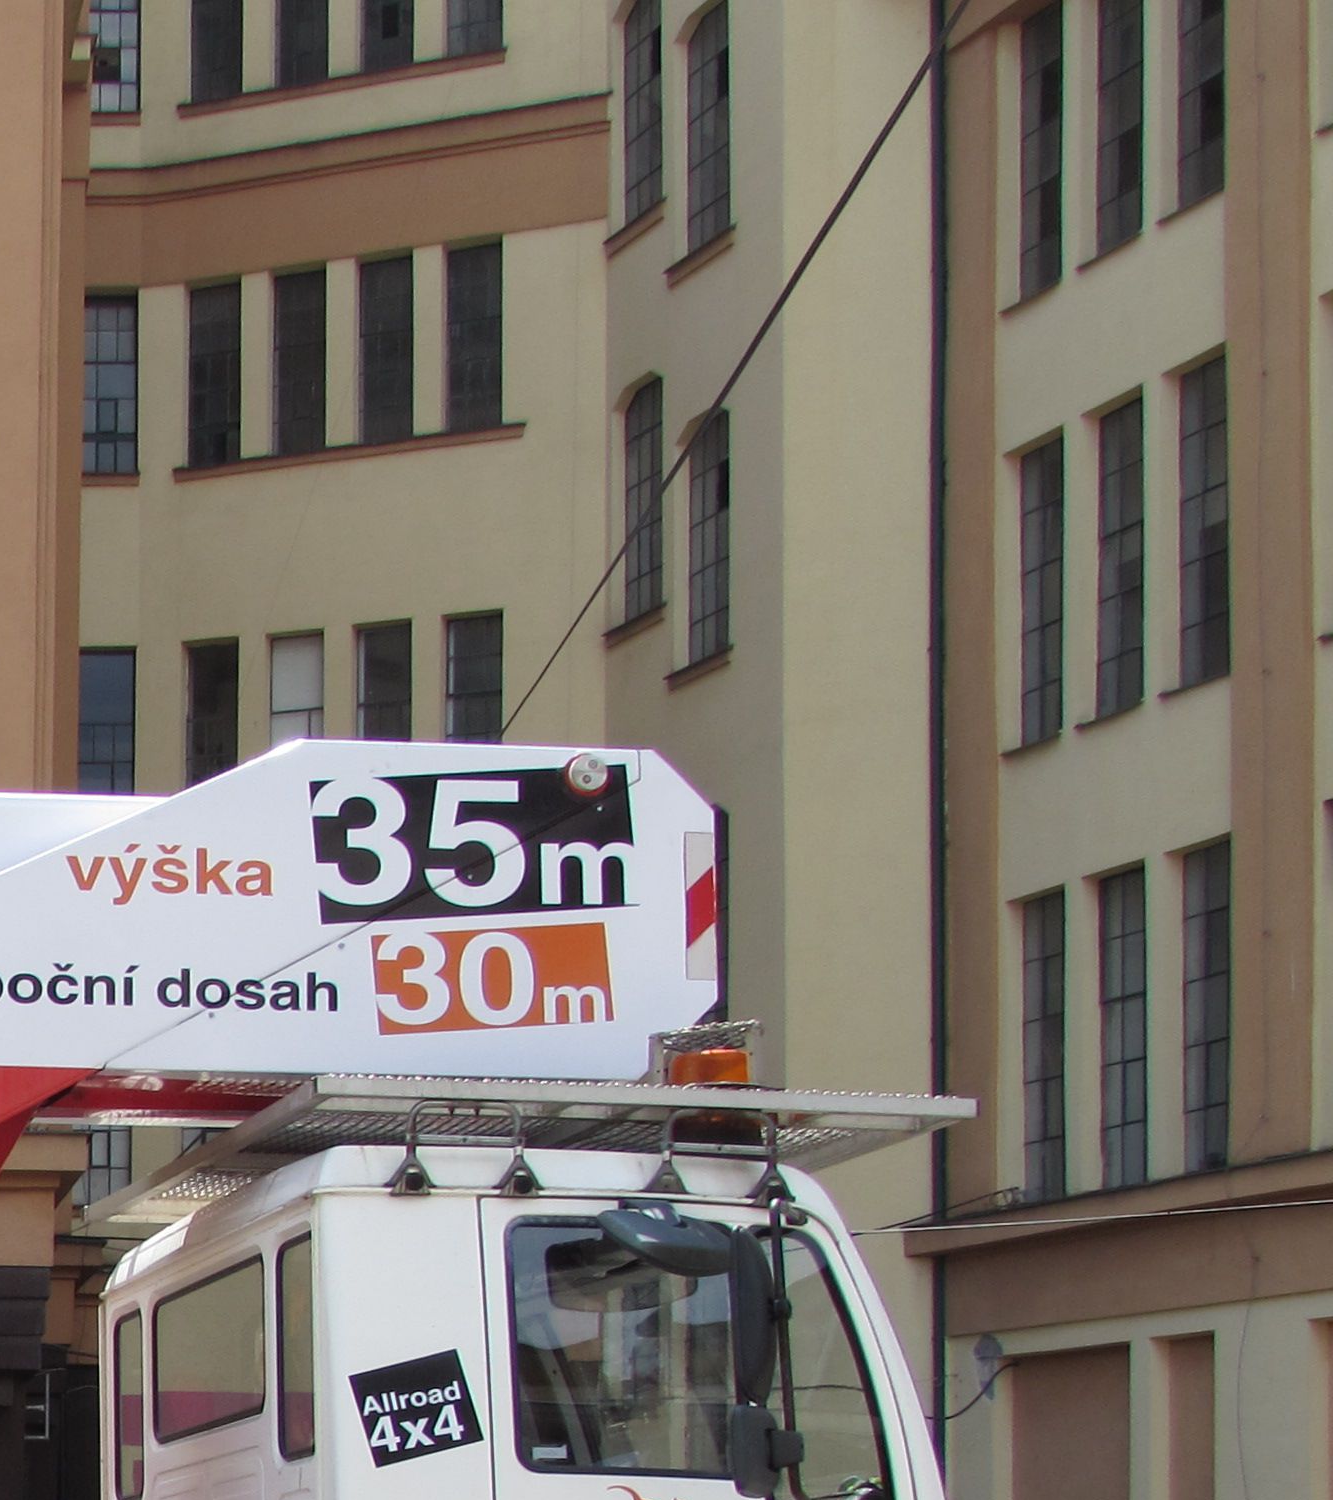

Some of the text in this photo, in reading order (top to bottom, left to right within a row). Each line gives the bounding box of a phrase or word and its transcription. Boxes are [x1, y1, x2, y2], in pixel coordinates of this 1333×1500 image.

[66, 843, 274, 905] výška
[157, 967, 339, 1012] dosah
[362, 1380, 463, 1417] Allroad
[368, 1404, 465, 1453] 4x4
